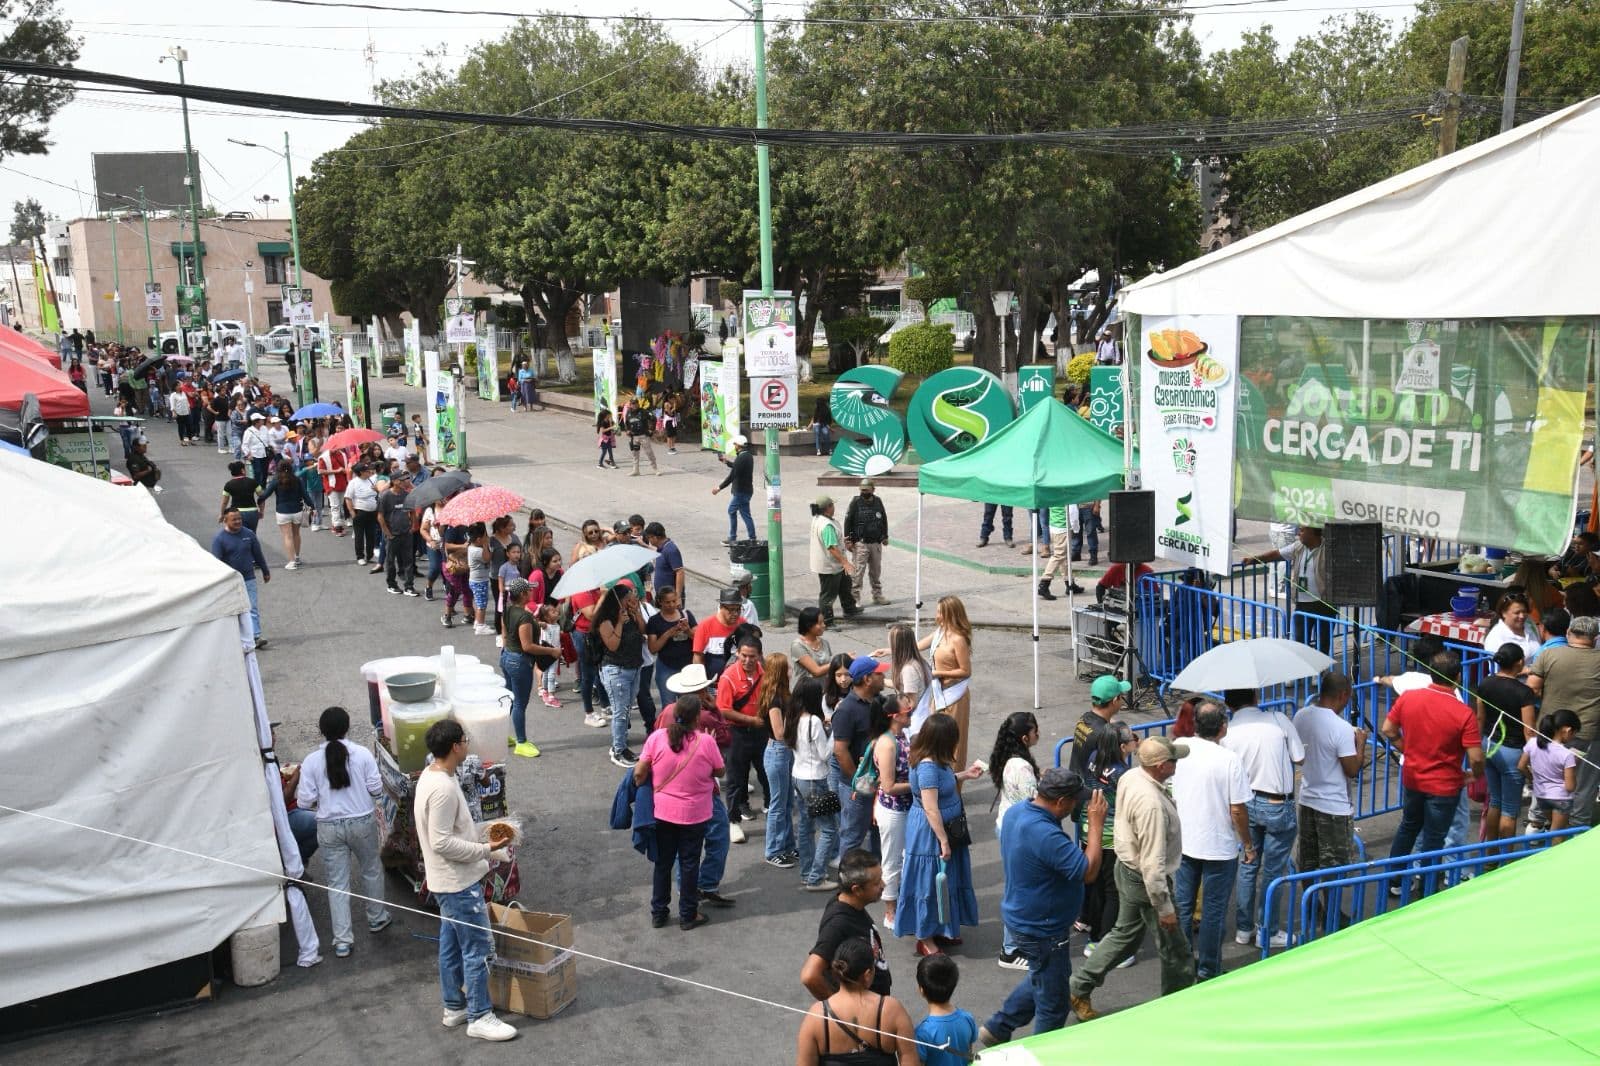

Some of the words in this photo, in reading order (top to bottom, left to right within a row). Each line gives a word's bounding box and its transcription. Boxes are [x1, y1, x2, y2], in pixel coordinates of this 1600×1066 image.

[1263, 419, 1372, 463] CERCA
[1382, 427, 1436, 467] DE
[1280, 486, 1327, 511] 2024
[1342, 500, 1440, 528] GOBIERNO
[1158, 536, 1187, 552] CERCA
[1187, 543, 1200, 555] DE
[1165, 528, 1202, 545] SOLEDAD
